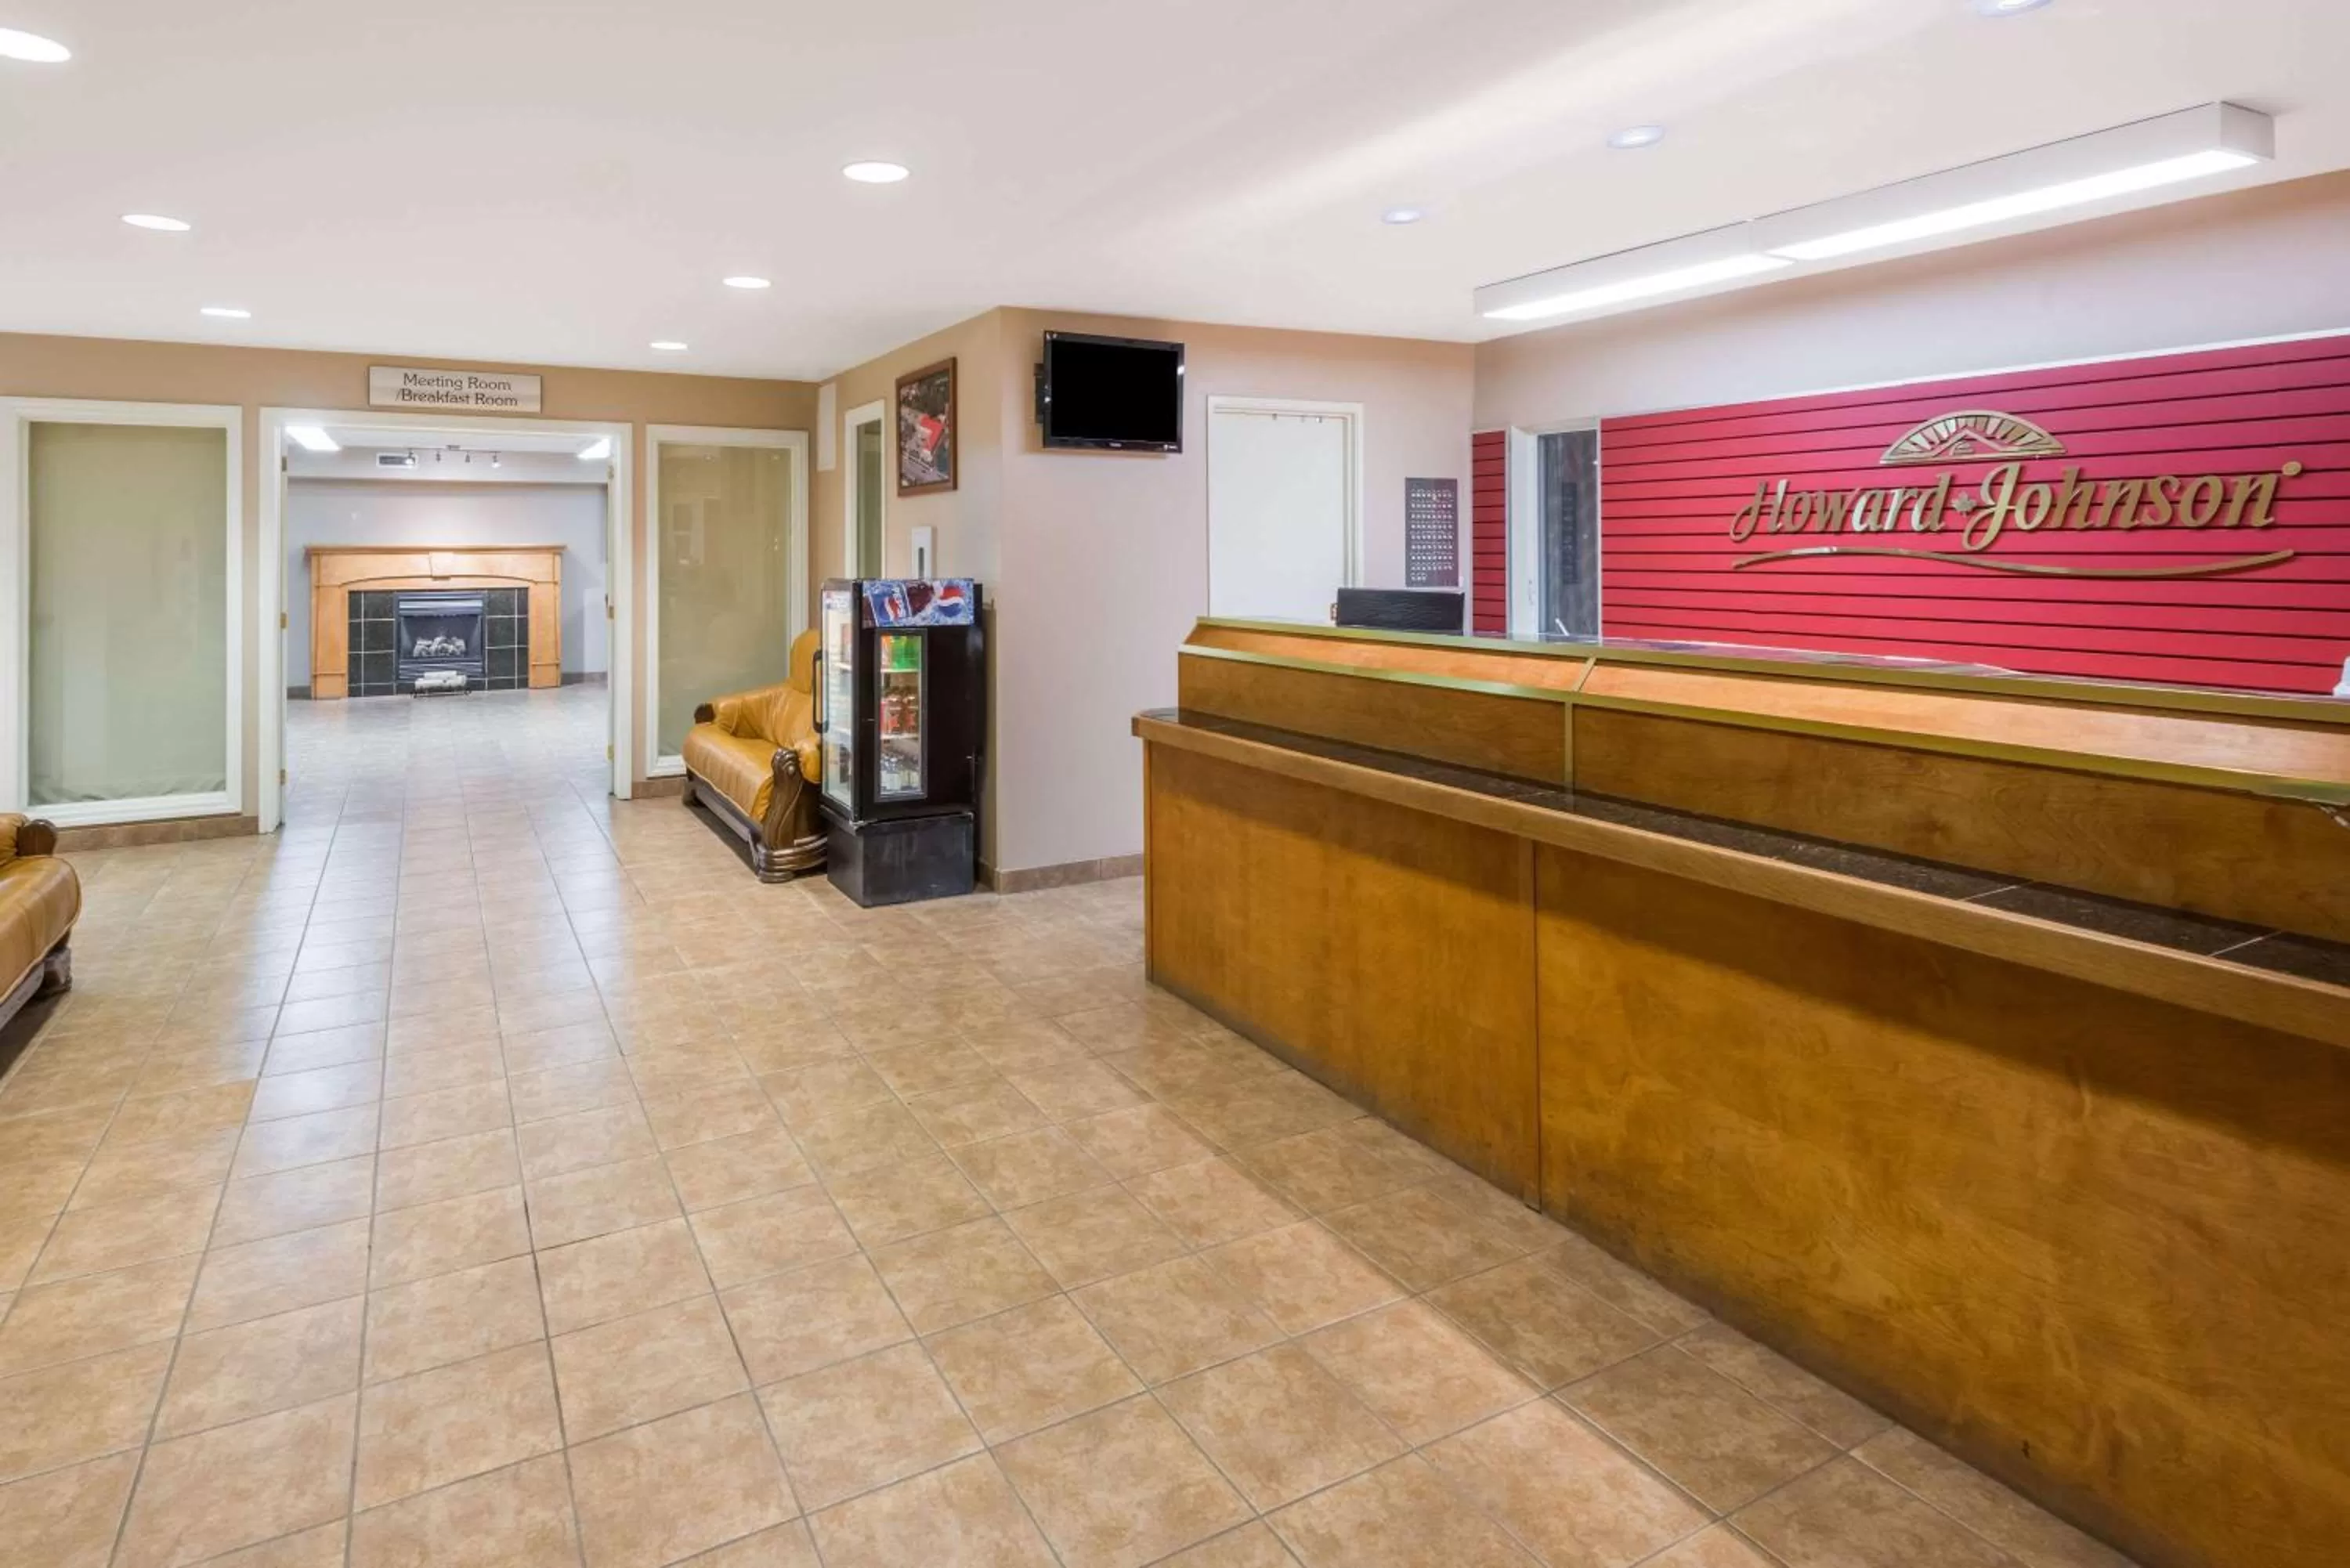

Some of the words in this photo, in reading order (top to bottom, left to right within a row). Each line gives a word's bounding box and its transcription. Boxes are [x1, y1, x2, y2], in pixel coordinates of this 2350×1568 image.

[403, 372, 464, 390] Meeting
[468, 377, 512, 391] Room
[475, 392, 518, 406] Room
[1729, 471, 1953, 541] Howard
[1961, 462, 2276, 551] Johnson
